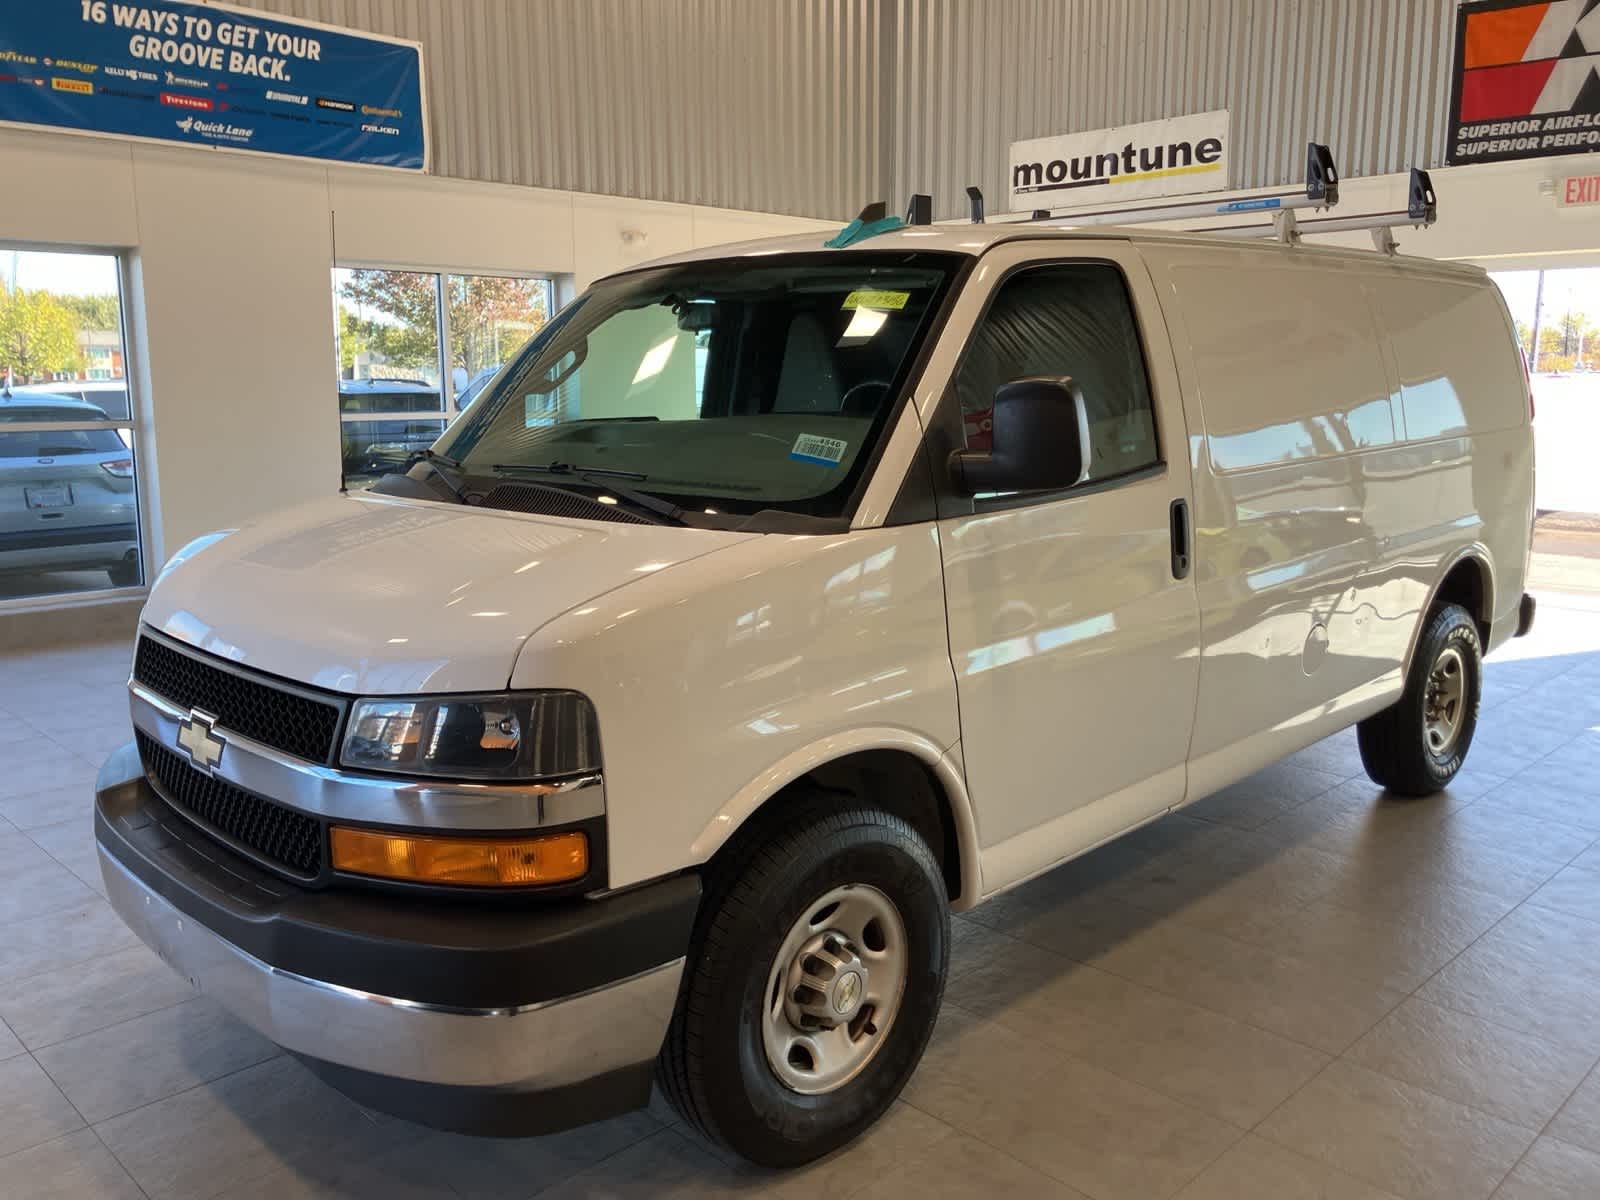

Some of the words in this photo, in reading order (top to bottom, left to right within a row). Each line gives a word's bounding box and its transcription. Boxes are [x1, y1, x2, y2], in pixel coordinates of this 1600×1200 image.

[82, 0, 107, 24] 16
[112, 4, 179, 36] WAYS
[183, 15, 212, 41] TO
[216, 22, 260, 50] GET
[264, 31, 321, 61] YOUR
[129, 34, 224, 71] GROOVE
[228, 51, 291, 82] BACK.
[192, 120, 225, 134] Quick
[225, 124, 254, 138] Lane
[1457, 119, 1541, 139] SUPERIOR
[1456, 137, 1540, 156] SUPERIOR
[1541, 131, 1600, 148] PERFO
[1013, 137, 1222, 187] mountune
[1565, 176, 1600, 203] EXIT
